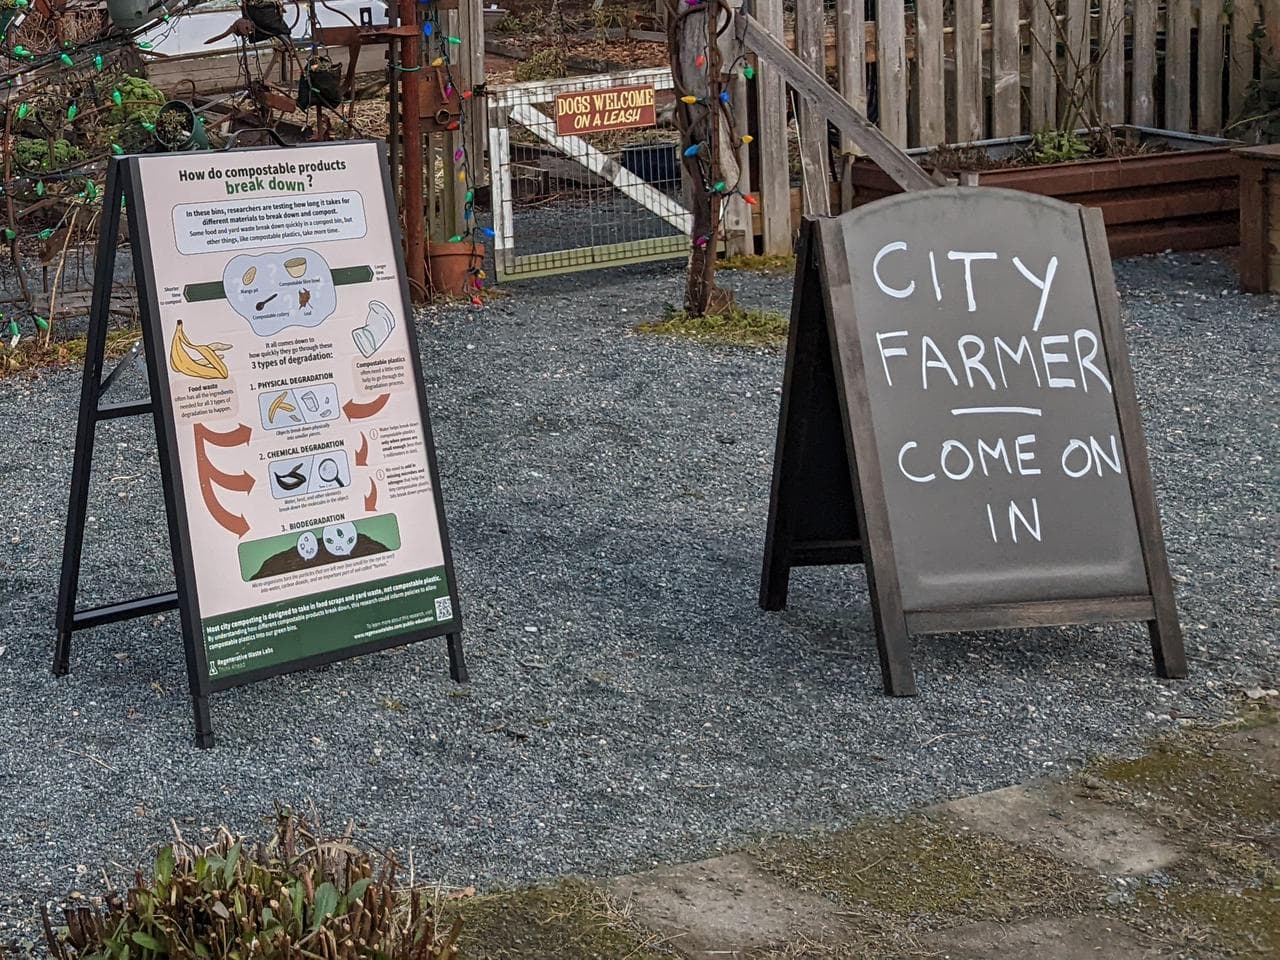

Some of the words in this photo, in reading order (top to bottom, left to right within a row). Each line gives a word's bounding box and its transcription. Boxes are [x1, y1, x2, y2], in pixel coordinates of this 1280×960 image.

[558, 95, 590, 116] DOGS
[592, 89, 654, 112] WELCOME
[574, 114, 589, 129] ON
[593, 112, 602, 127] A
[603, 108, 641, 125] LEASH
[179, 170, 206, 181] How
[207, 168, 223, 179] do
[225, 163, 296, 179] compostable
[298, 159, 346, 175] products
[225, 177, 265, 195] break
[268, 175, 306, 194] down
[307, 174, 314, 187] ?
[202, 217, 229, 225] different
[229, 215, 258, 223] materials
[265, 212, 282, 220] break
[312, 208, 338, 216] compost.
[227, 205, 261, 214] researchers
[285, 221, 303, 229] quickly
[313, 218, 334, 226] compost
[249, 233, 281, 241] compostable
[281, 231, 303, 239] plastics,
[872, 241, 1058, 331] CITY
[251, 361, 257, 369] 3
[257, 360, 278, 370] types
[278, 357, 287, 365] of
[287, 352, 334, 365] degradation:
[261, 350, 280, 358] quickly
[356, 359, 387, 368] Compostable
[387, 357, 405, 365] plastics
[875, 328, 1112, 392] FARMER
[188, 385, 202, 393] Food
[250, 383, 256, 391] 1.
[257, 378, 289, 390] PHYSICAL
[289, 372, 334, 385] DEGRADATION
[181, 410, 208, 418] degradation
[267, 447, 300, 459] CHEMICAL
[300, 440, 344, 453] DEGRADATION
[898, 434, 1042, 482] COME
[1061, 435, 1122, 478] ON
[289, 513, 345, 530] BIODEGRADATION
[987, 498, 1042, 543] IN
[206, 624, 220, 634] Most
[220, 622, 231, 630] city
[231, 616, 263, 628] composting
[267, 608, 292, 620] designed
[298, 604, 310, 613] take
[316, 600, 328, 609] food
[328, 597, 345, 606] scraps
[345, 594, 355, 602] and
[355, 591, 367, 601] yard
[367, 588, 384, 597] waste,
[384, 585, 392, 594] not
[392, 579, 424, 592] compostable
[423, 575, 442, 586] plastic.
[217, 654, 248, 666] Regenerative
[248, 650, 262, 659] Waste
[262, 647, 274, 655] Labs
